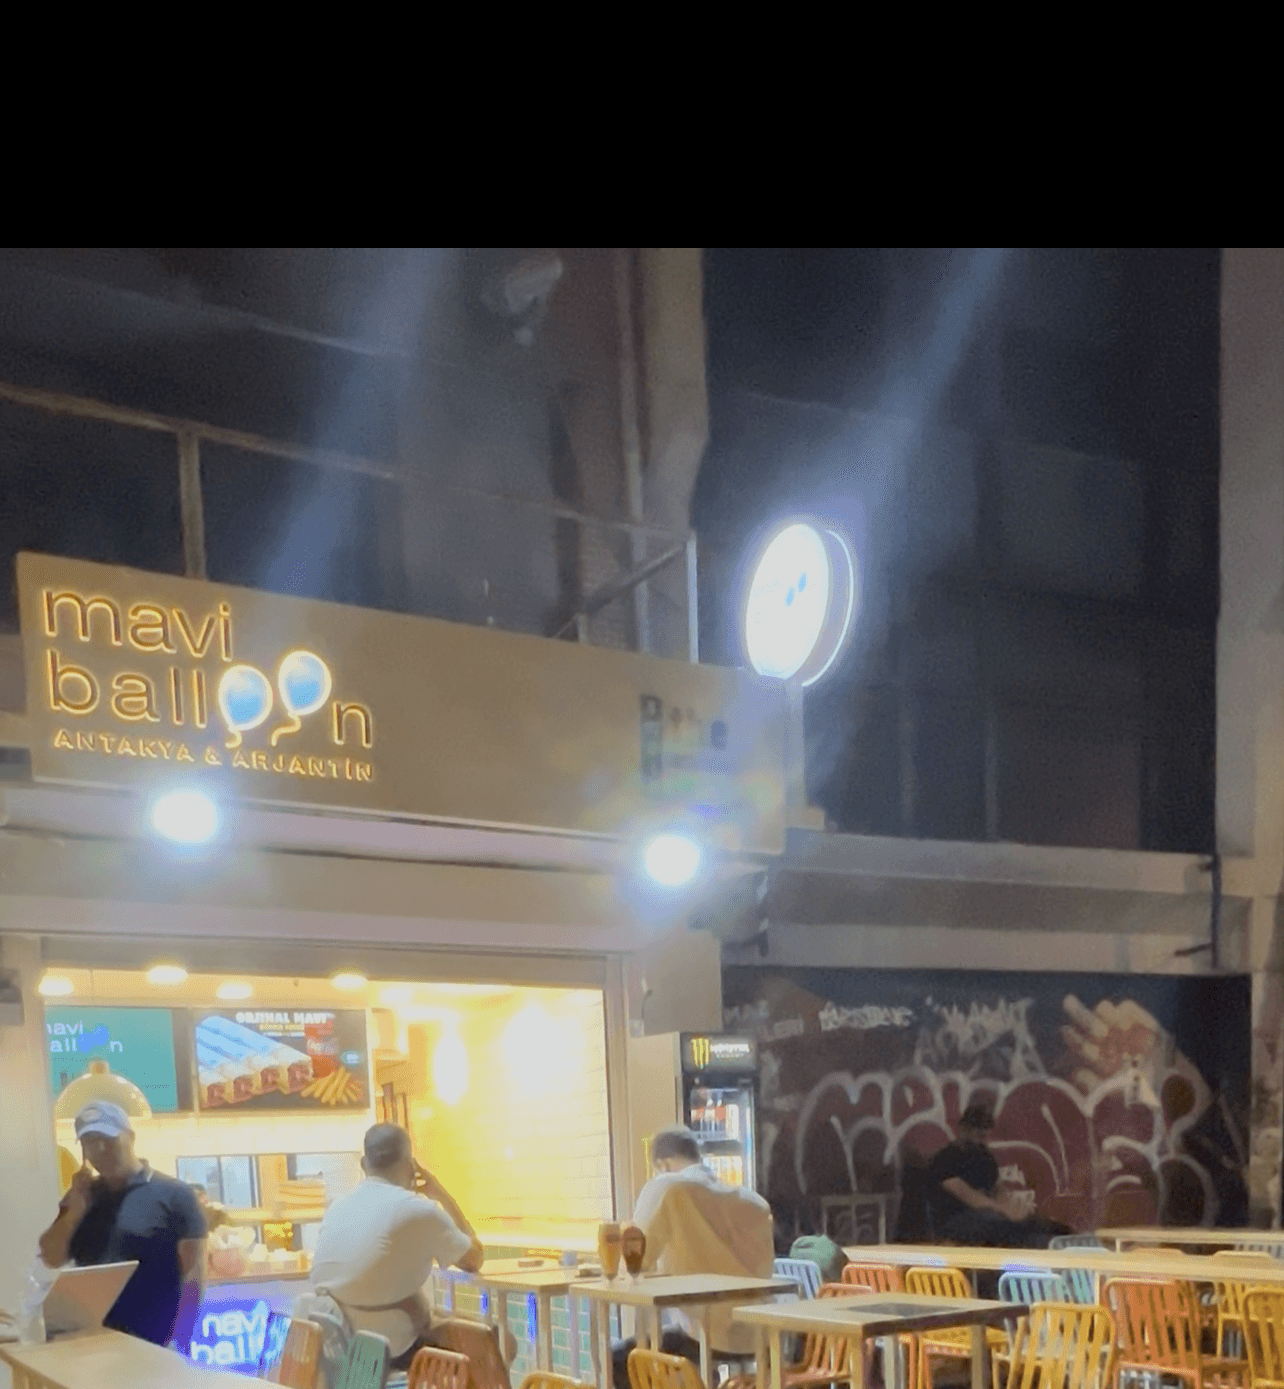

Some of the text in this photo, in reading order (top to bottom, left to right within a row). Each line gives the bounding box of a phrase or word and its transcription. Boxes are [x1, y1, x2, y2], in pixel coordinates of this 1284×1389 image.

[42, 588, 234, 662] mavi
[52, 728, 195, 763] ANTAKYA
[204, 746, 223, 766] &
